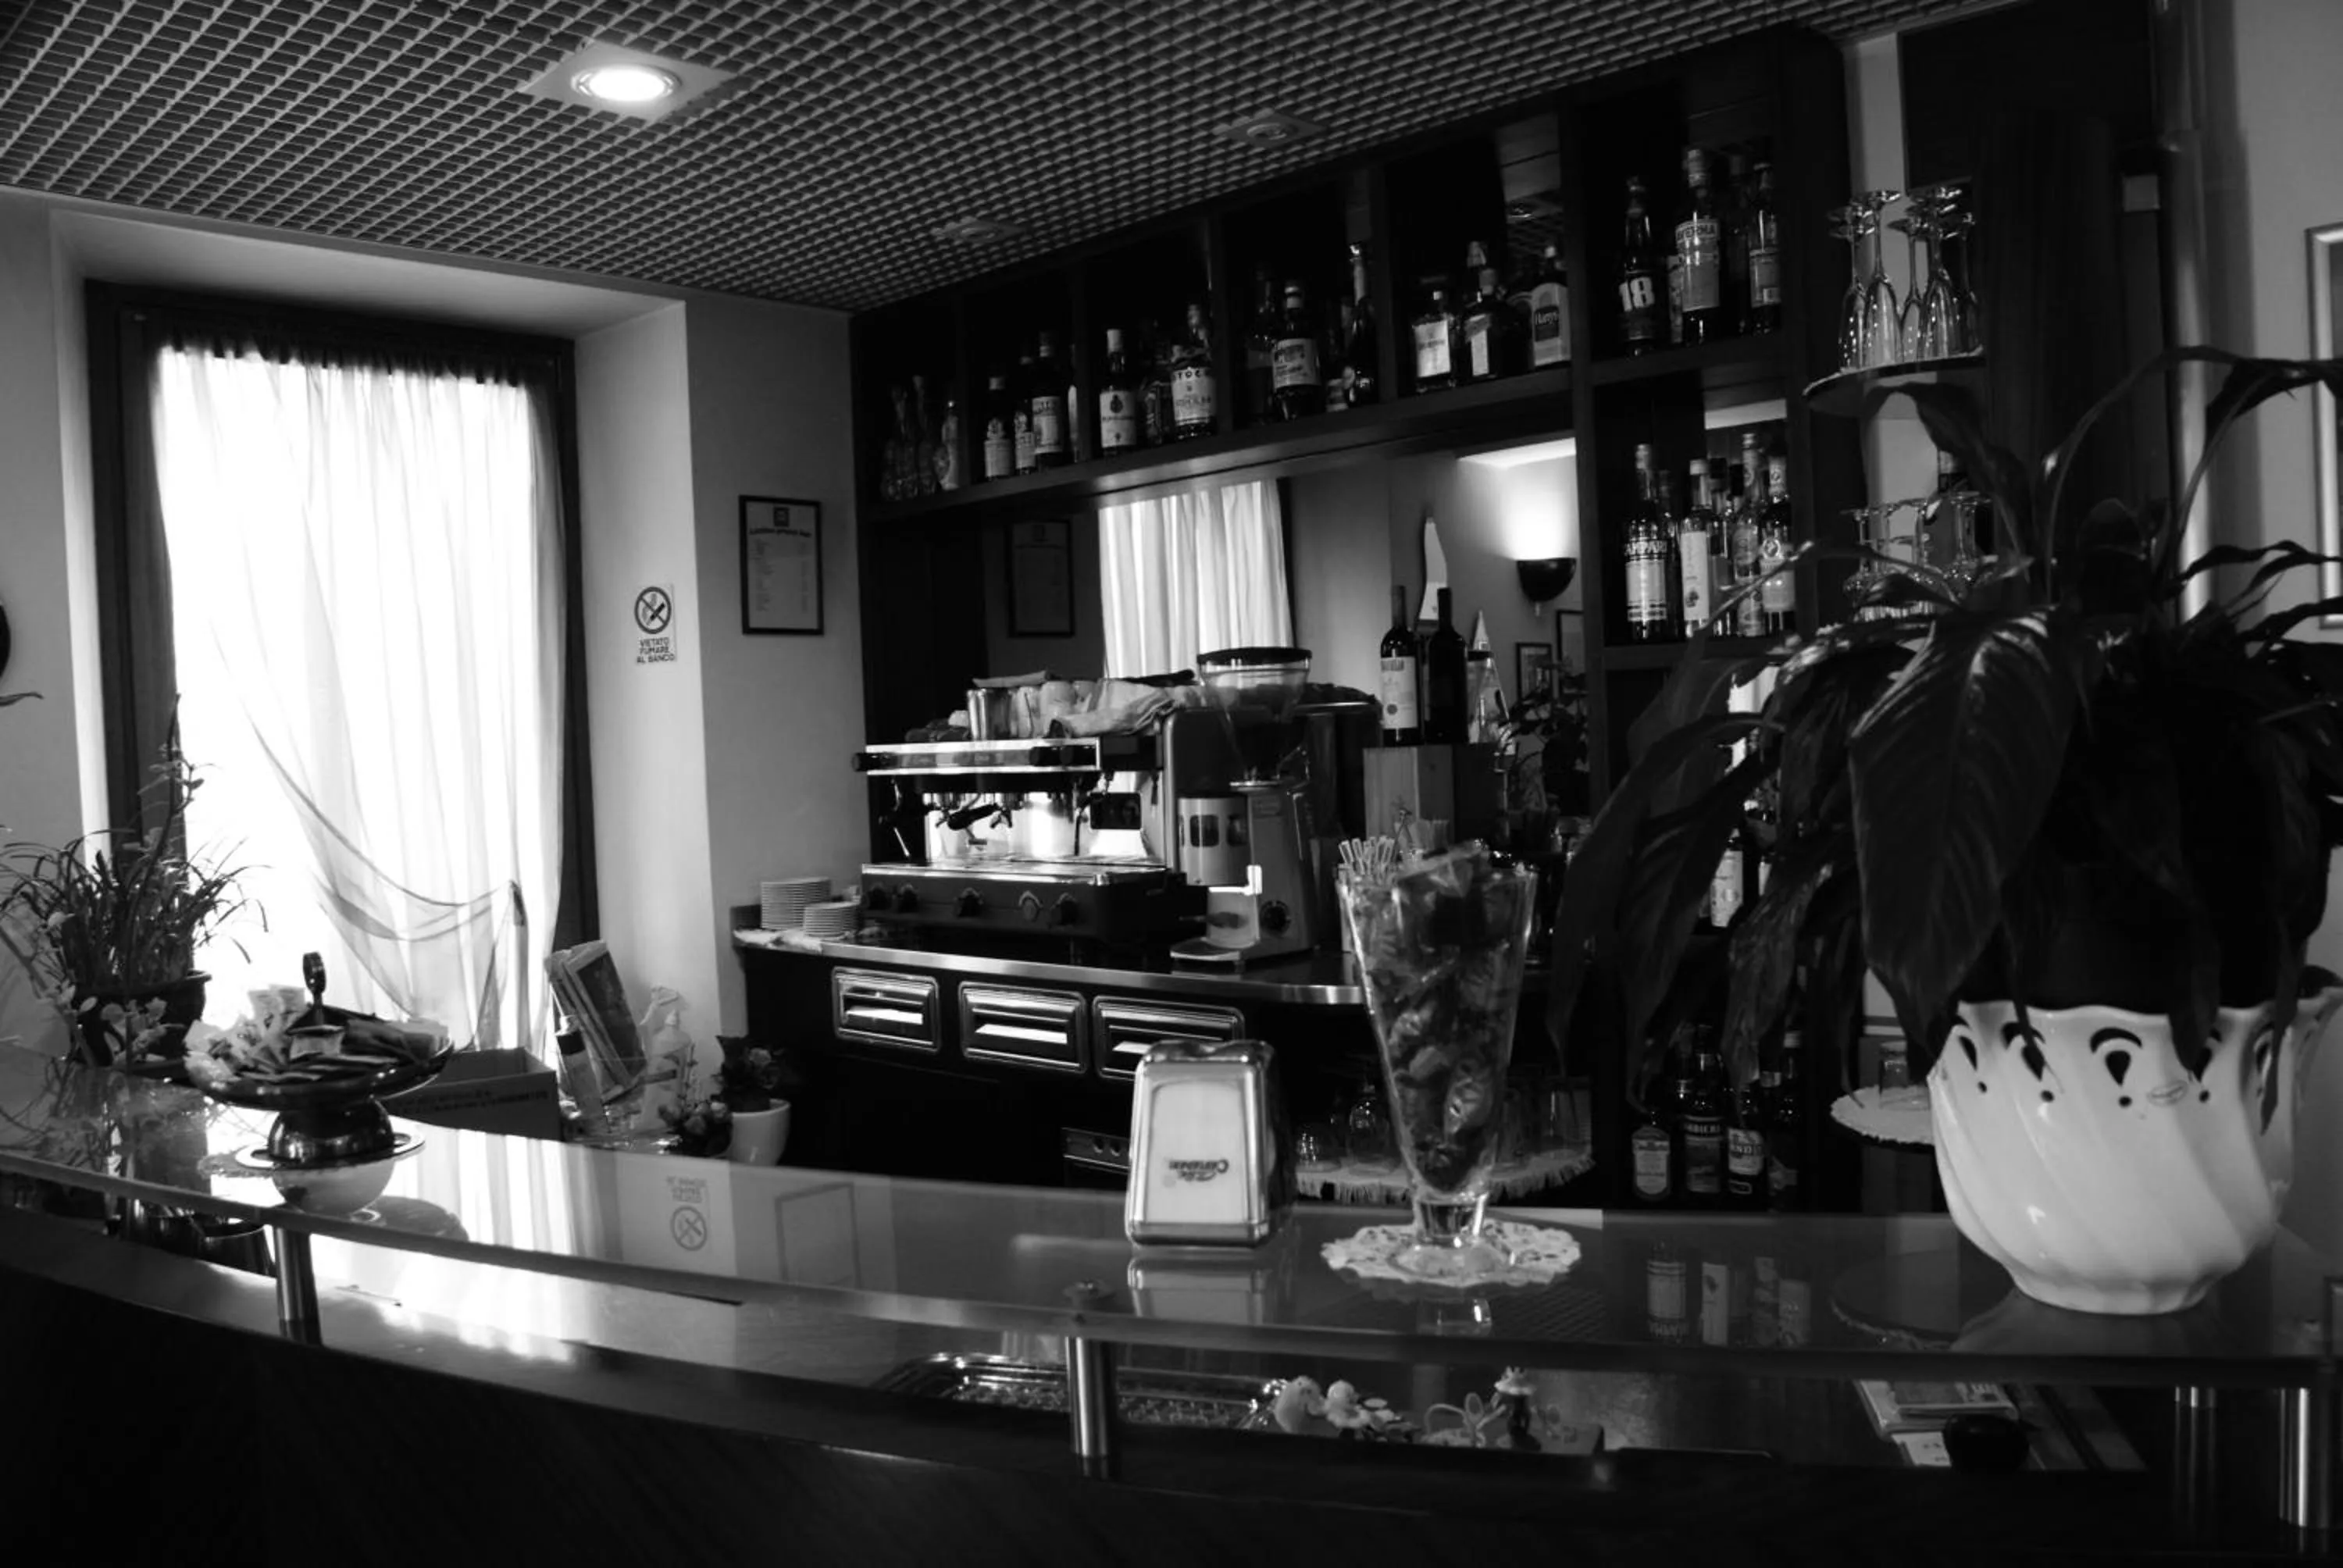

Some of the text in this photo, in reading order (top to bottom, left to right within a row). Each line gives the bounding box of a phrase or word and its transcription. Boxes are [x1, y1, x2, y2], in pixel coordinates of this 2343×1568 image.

[1618, 276, 1656, 313] 18
[640, 636, 669, 647] VIETATO
[639, 646, 669, 654] FUMARE
[637, 654, 676, 664] AL BANCO
